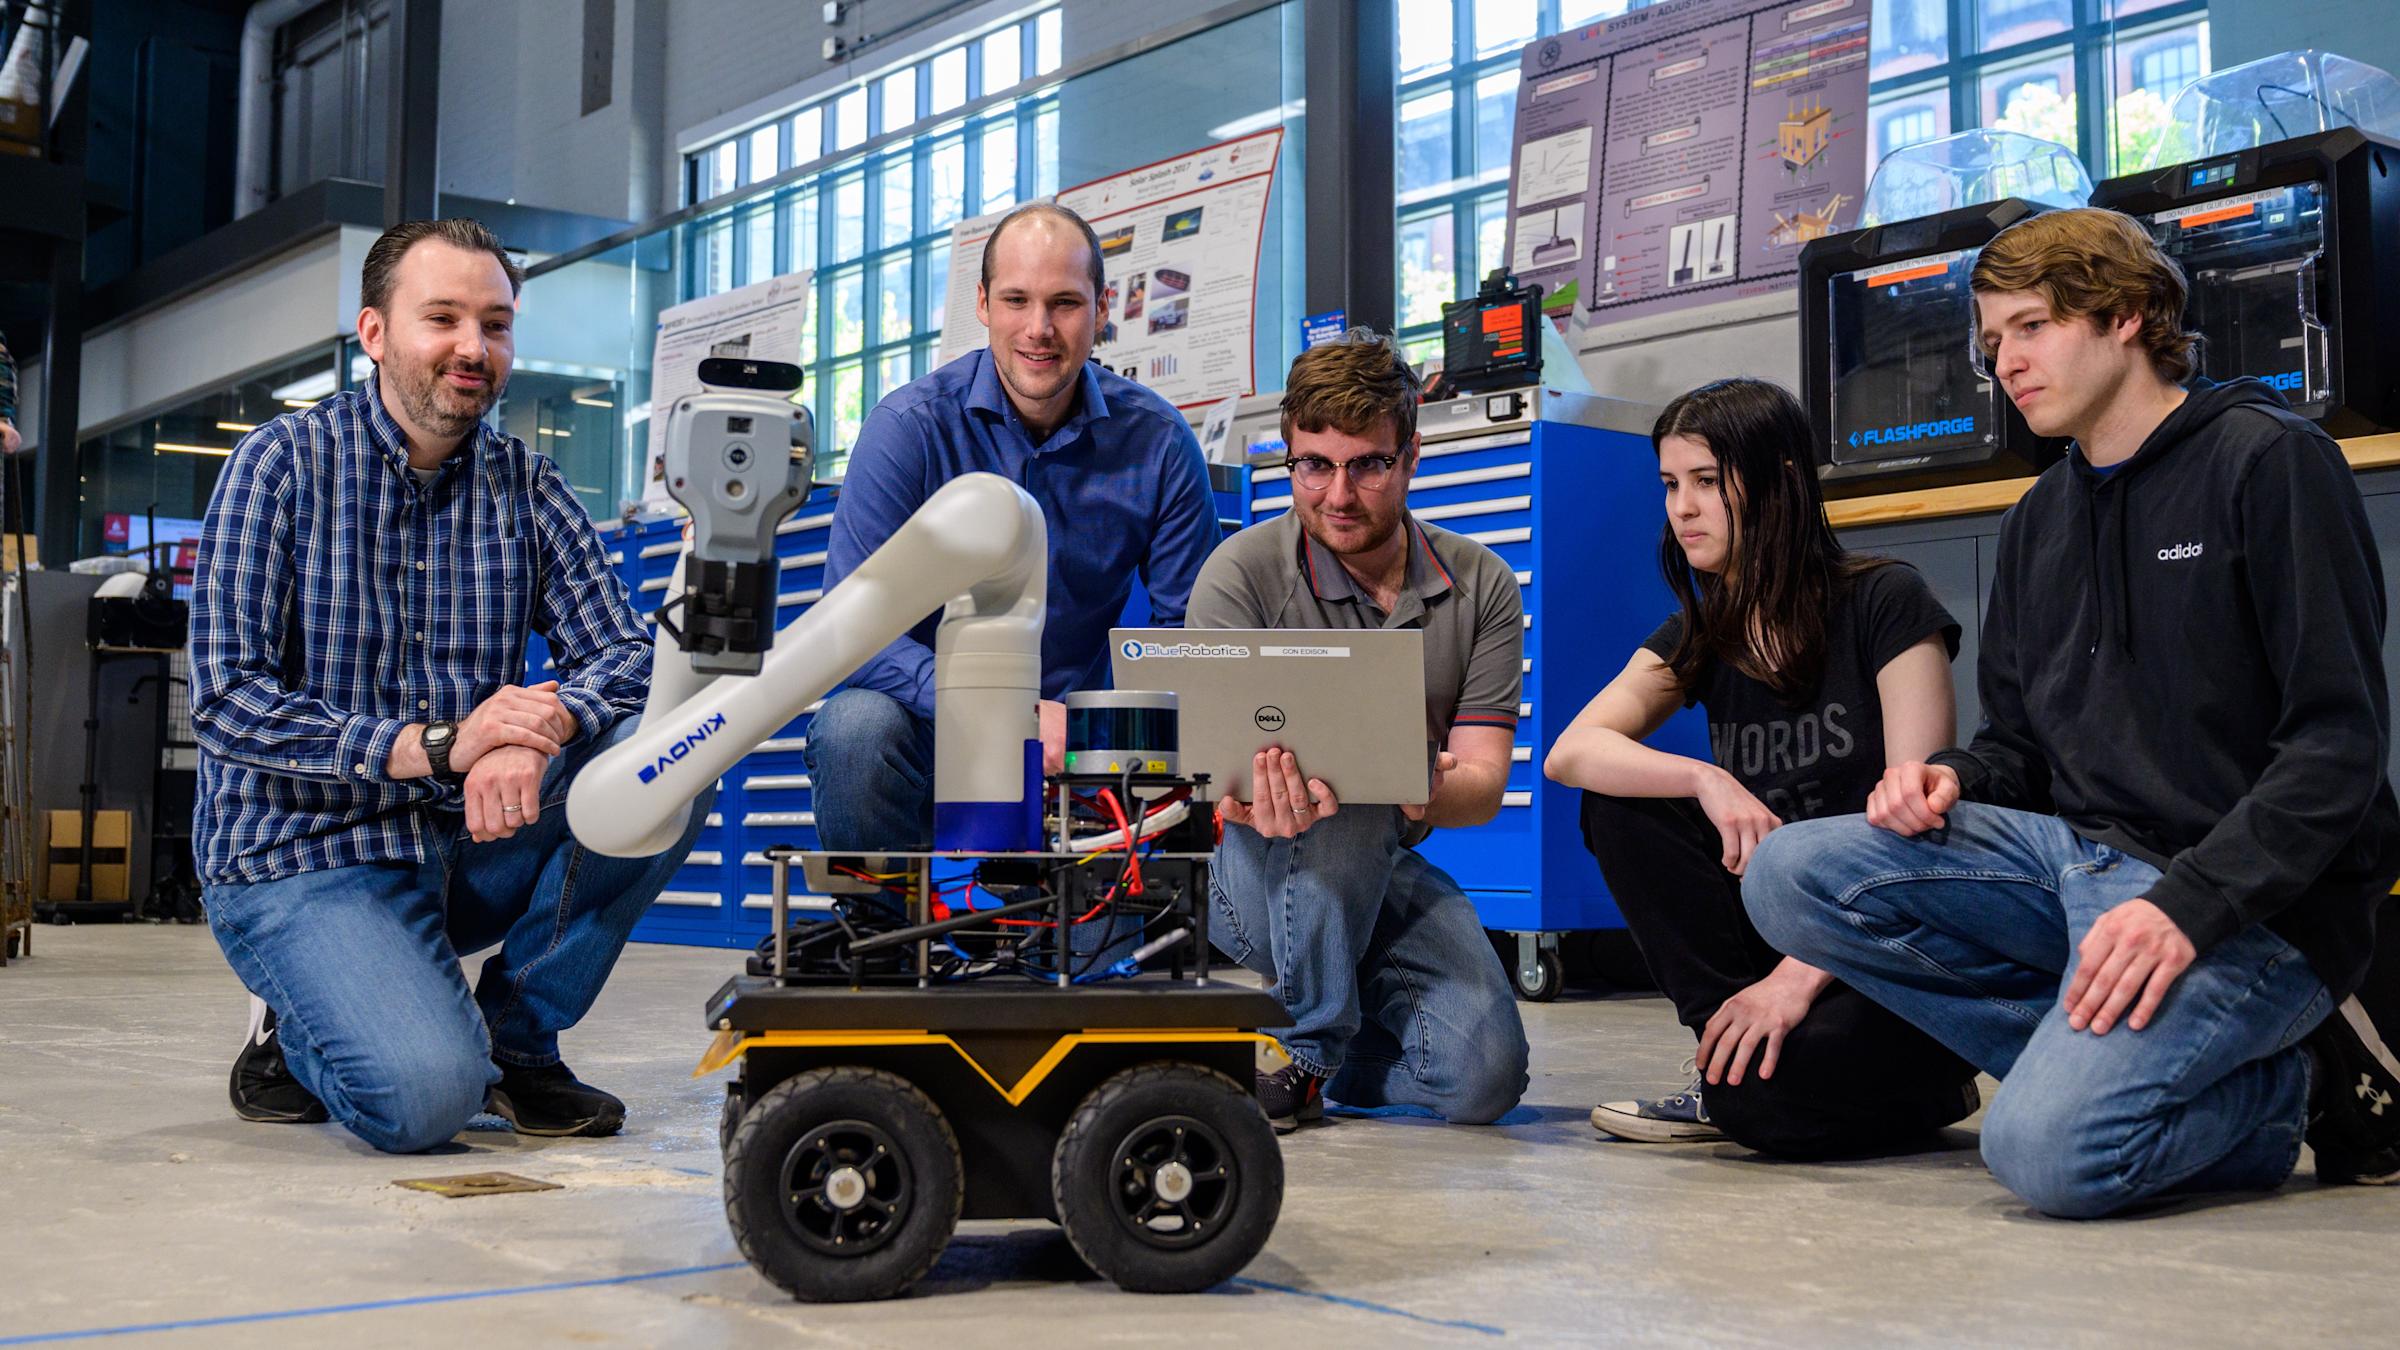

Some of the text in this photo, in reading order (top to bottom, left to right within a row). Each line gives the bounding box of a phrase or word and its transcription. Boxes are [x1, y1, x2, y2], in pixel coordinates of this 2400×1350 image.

[1608, 14, 1649, 33] SYSTEM
[2177, 208, 2190, 216] NOT
[2206, 201, 2223, 210] GLUE
[2237, 194, 2256, 203] PRINT
[1864, 416, 1974, 446] FLASHFORGE
[1144, 645, 1249, 657] BlueRobotics
[1711, 702, 1854, 776] WORDS
